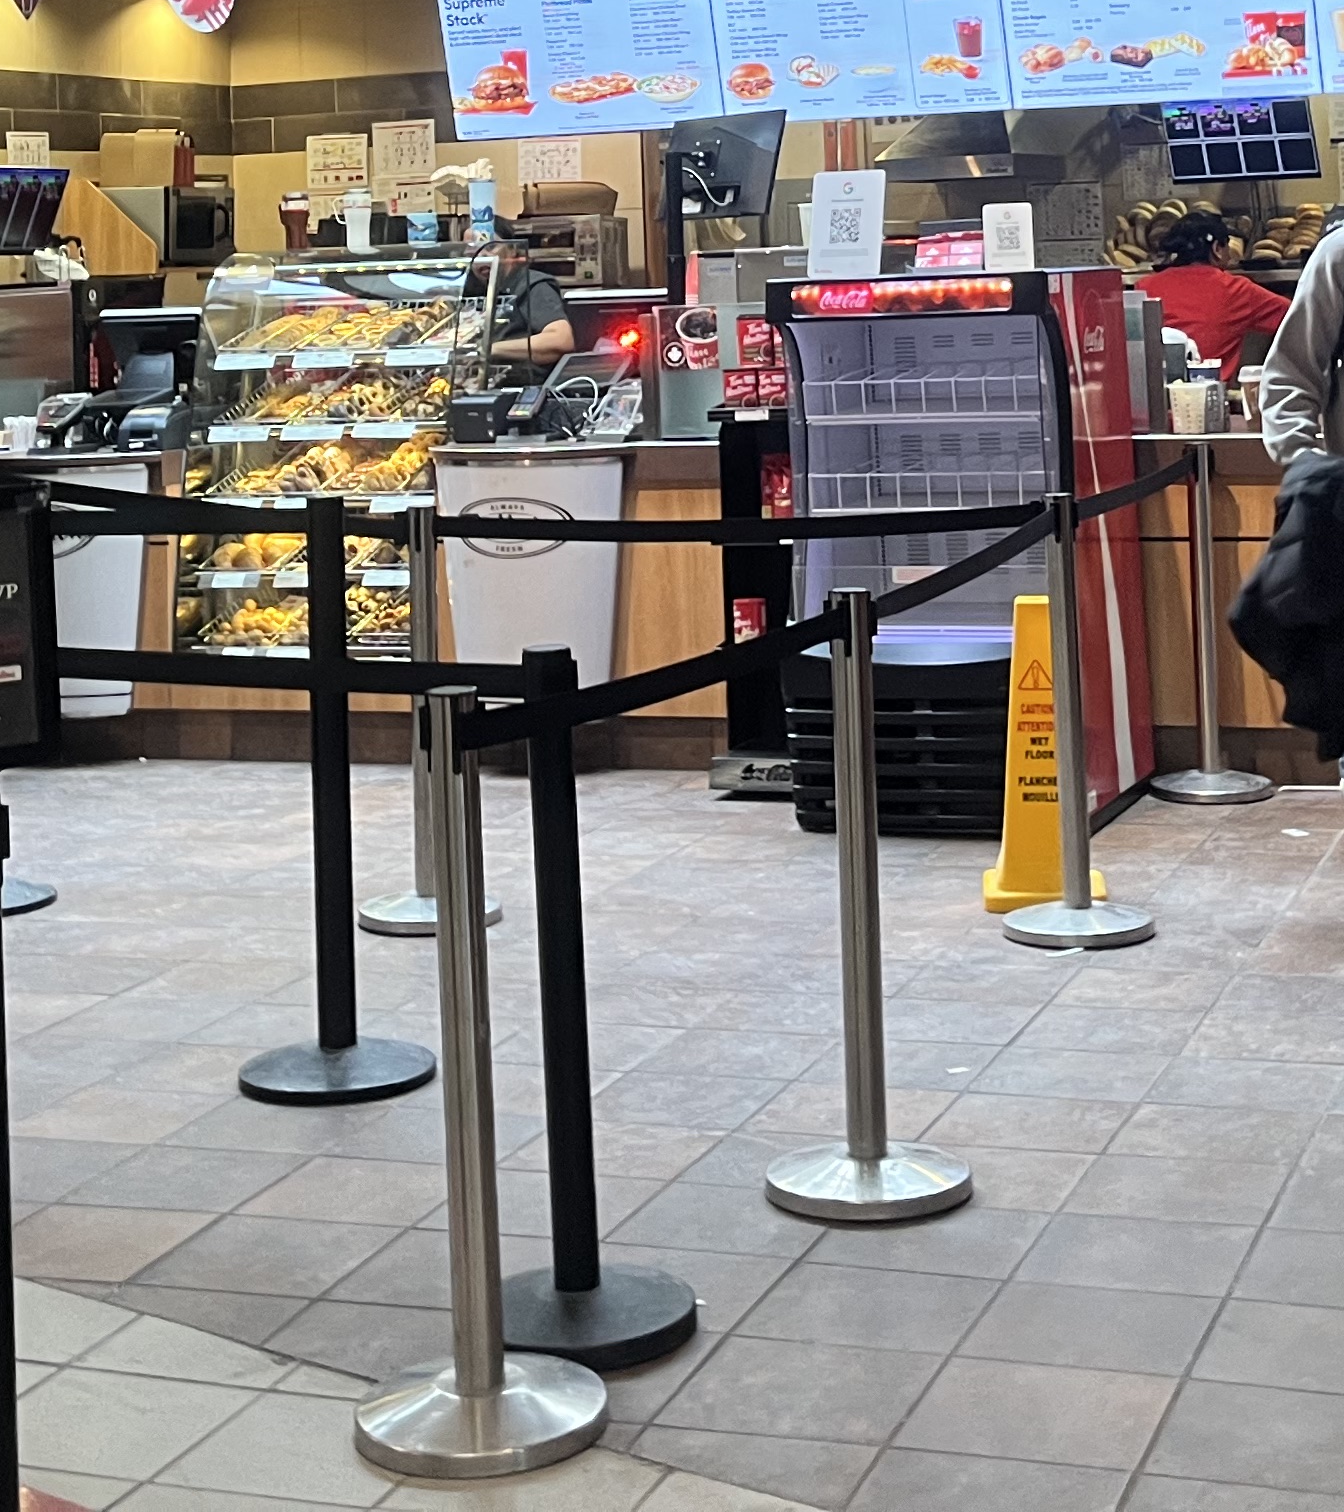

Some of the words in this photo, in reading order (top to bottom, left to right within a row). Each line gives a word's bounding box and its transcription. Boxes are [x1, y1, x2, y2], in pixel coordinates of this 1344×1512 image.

[447, 13, 485, 27] Stack
[1017, 721, 1054, 732] ATTENTIO
[1030, 737, 1049, 746] WET
[1025, 750, 1055, 760] FLOOR
[1018, 776, 1058, 787] PLANCHE
